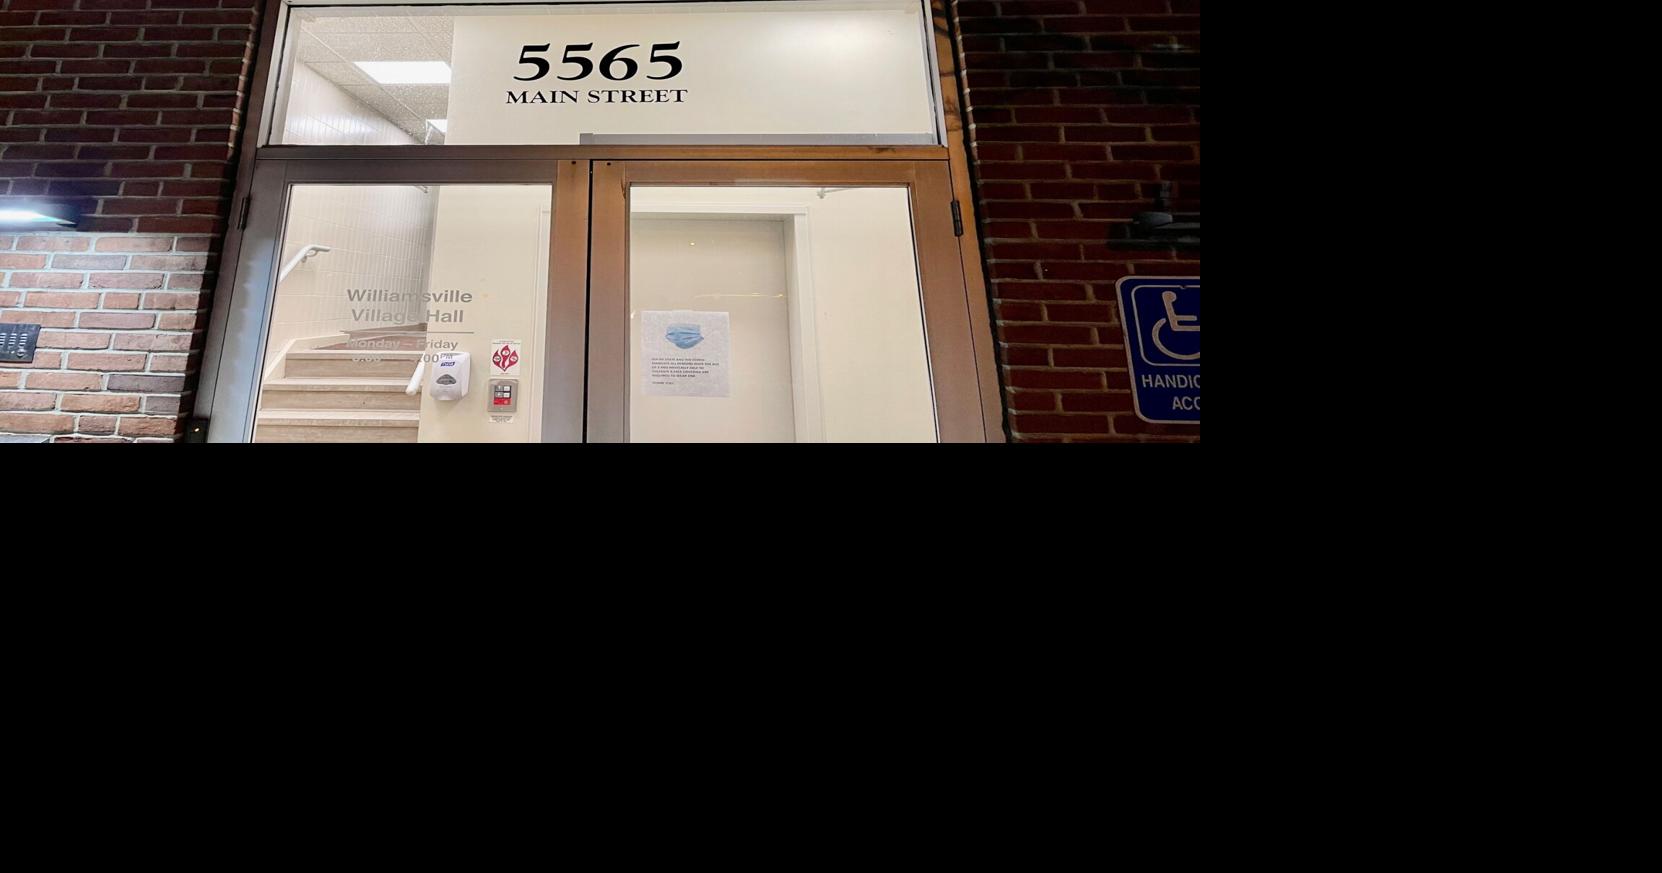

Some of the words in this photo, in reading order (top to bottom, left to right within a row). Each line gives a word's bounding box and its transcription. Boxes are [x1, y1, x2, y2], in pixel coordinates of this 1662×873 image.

[513, 41, 683, 81] 5565
[505, 90, 579, 104] MAIN
[587, 89, 688, 103] STREET
[347, 289, 473, 303] Williamsville
[351, 308, 418, 324] Village
[426, 309, 464, 323] Hall
[416, 339, 458, 351] Friday
